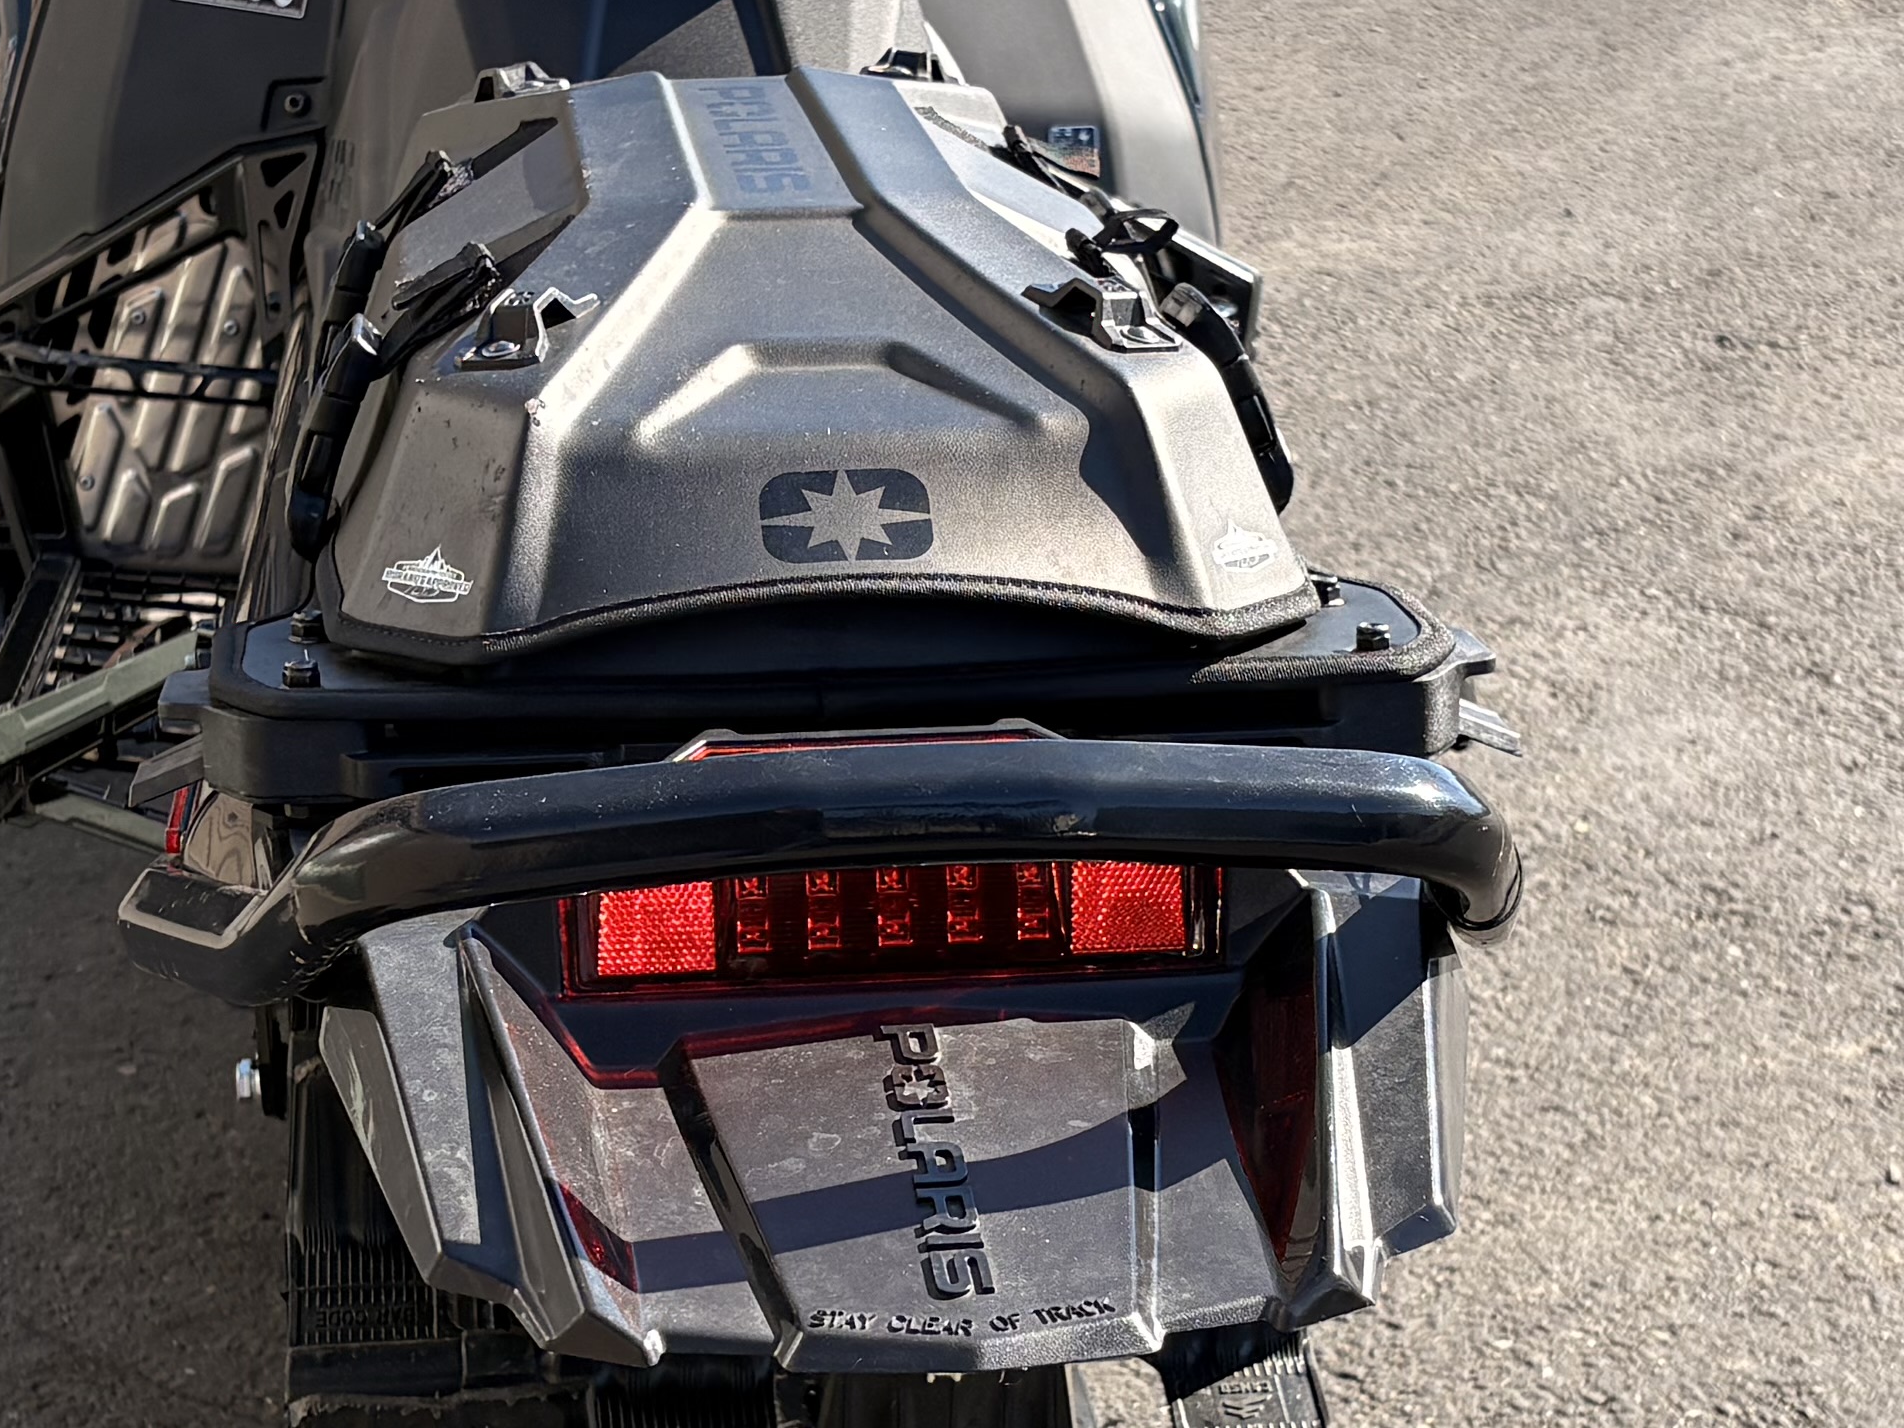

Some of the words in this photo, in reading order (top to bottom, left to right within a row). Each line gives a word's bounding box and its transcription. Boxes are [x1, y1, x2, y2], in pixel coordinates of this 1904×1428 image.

[697, 85, 814, 194] POLARIS
[873, 1023, 996, 1301] POLARIS
[807, 1309, 877, 1330] STAY
[886, 1314, 973, 1337] CLEAR
[989, 1312, 1021, 1332] OF
[1031, 1296, 1116, 1326] TRACK
